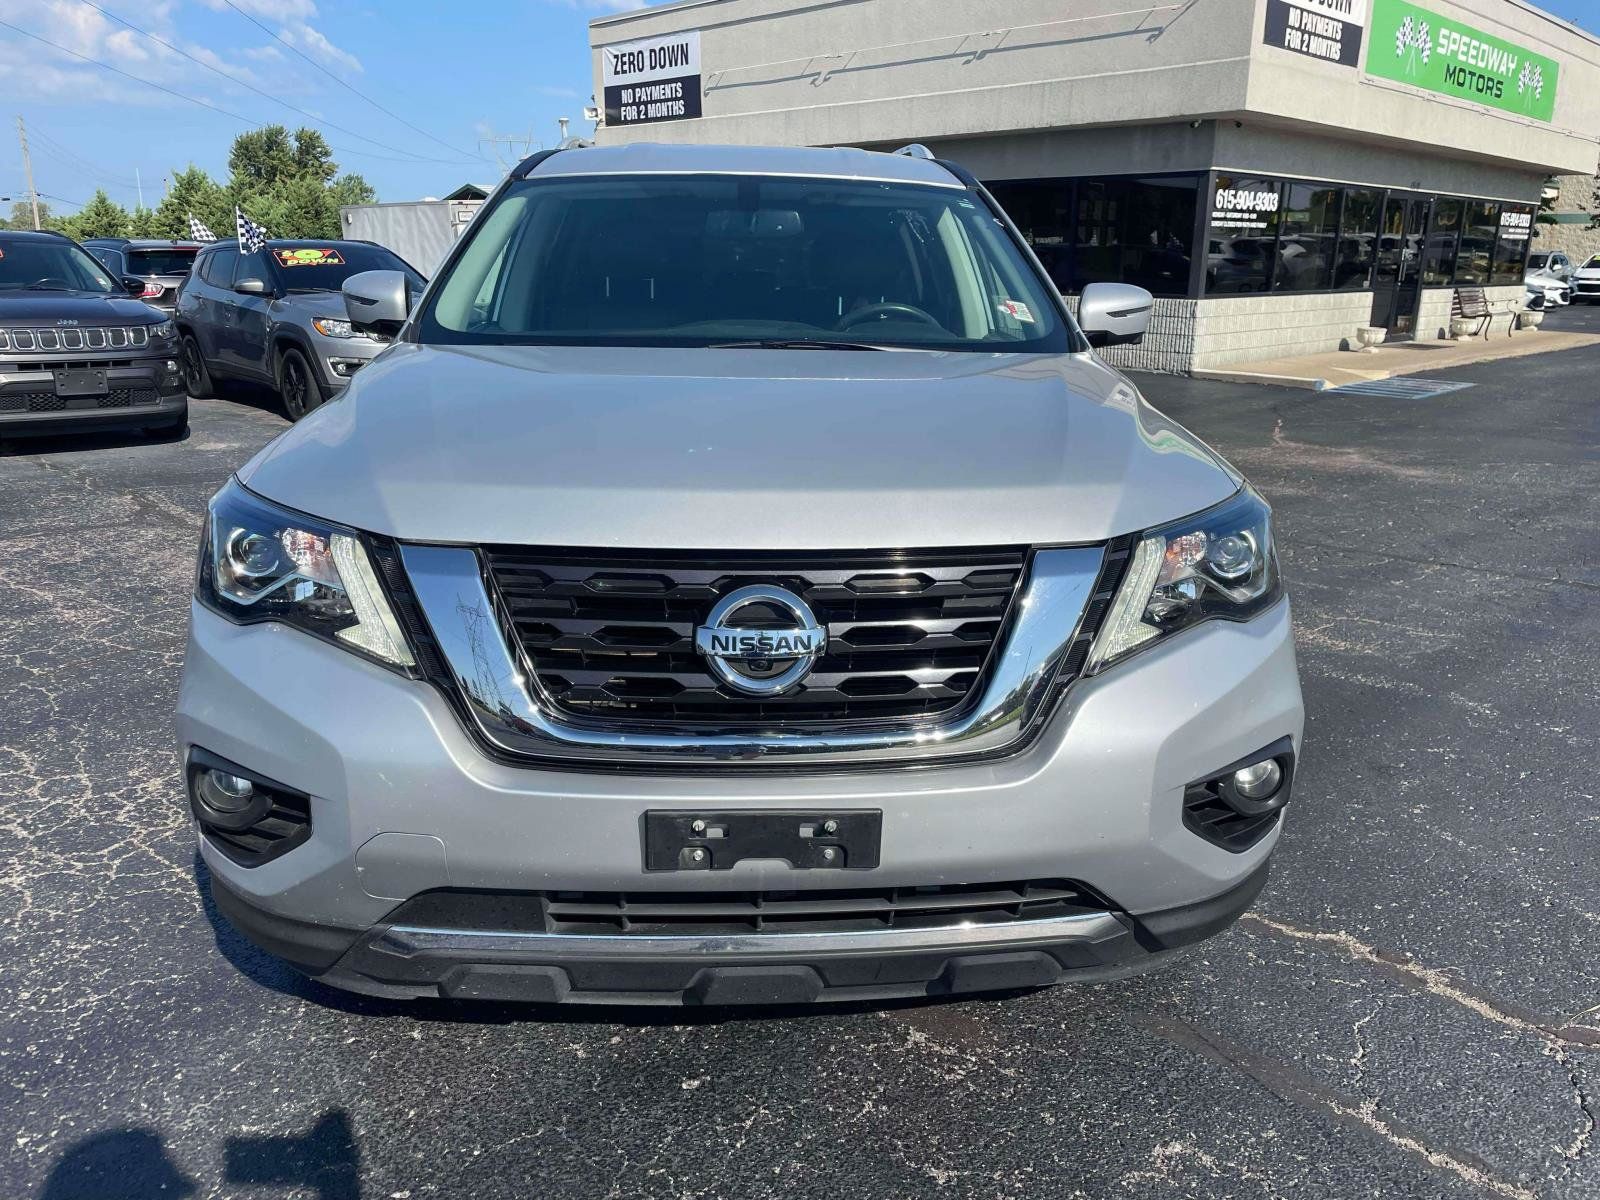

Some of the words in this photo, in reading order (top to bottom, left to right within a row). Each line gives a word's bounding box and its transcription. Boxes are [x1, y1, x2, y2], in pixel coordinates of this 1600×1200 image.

[1288, 7, 1301, 28] NO
[1301, 11, 1343, 40] PAYMENTS
[1284, 28, 1302, 50] FOR
[1302, 34, 1309, 52] 2
[1308, 35, 1342, 61] MONTHS
[1436, 28, 1518, 77] SPEEDWAY
[613, 50, 645, 75] ZERO
[649, 43, 689, 71] DOWN
[621, 89, 633, 104] NO
[635, 82, 683, 102] PAYMENTS
[1444, 64, 1504, 98] MOTORS
[621, 106, 638, 121] FOR
[639, 105, 646, 119] 2
[647, 100, 685, 118] MONTHS
[1215, 188, 1279, 212] 615-904-9303
[287, 257, 339, 265] DOWN
[711, 634, 812, 652] NISSAN
